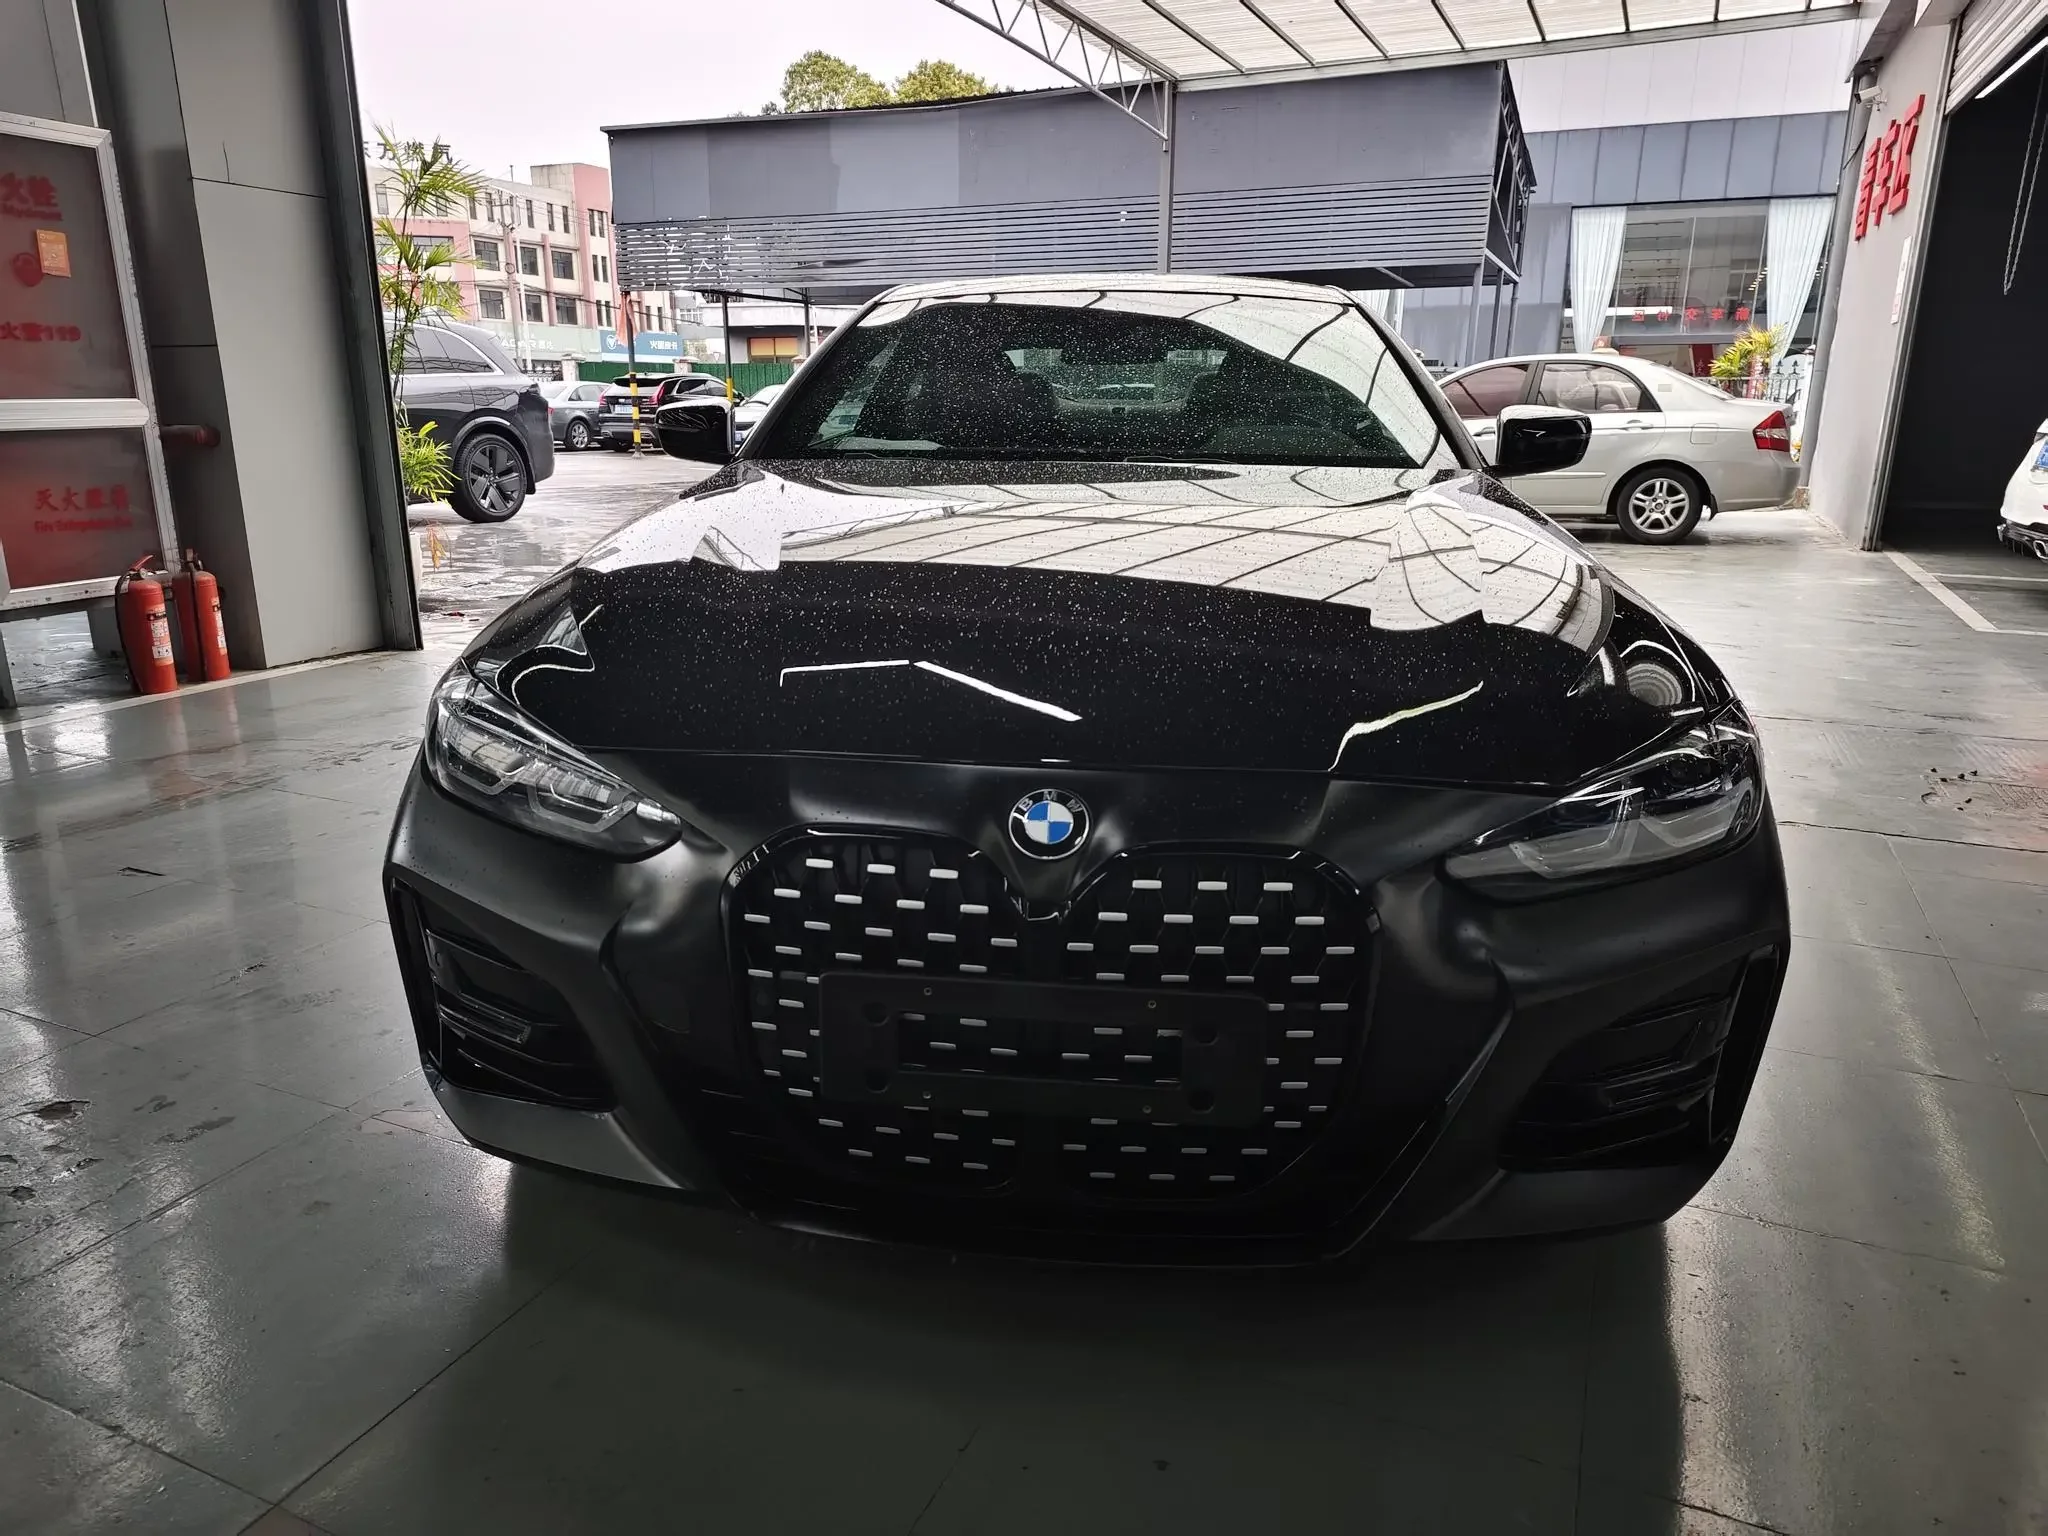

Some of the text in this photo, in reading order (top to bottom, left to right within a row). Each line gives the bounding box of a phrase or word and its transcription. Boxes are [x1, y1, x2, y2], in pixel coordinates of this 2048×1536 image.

[1855, 94, 1926, 242] 看车区
[1018, 790, 1083, 813] BMW
